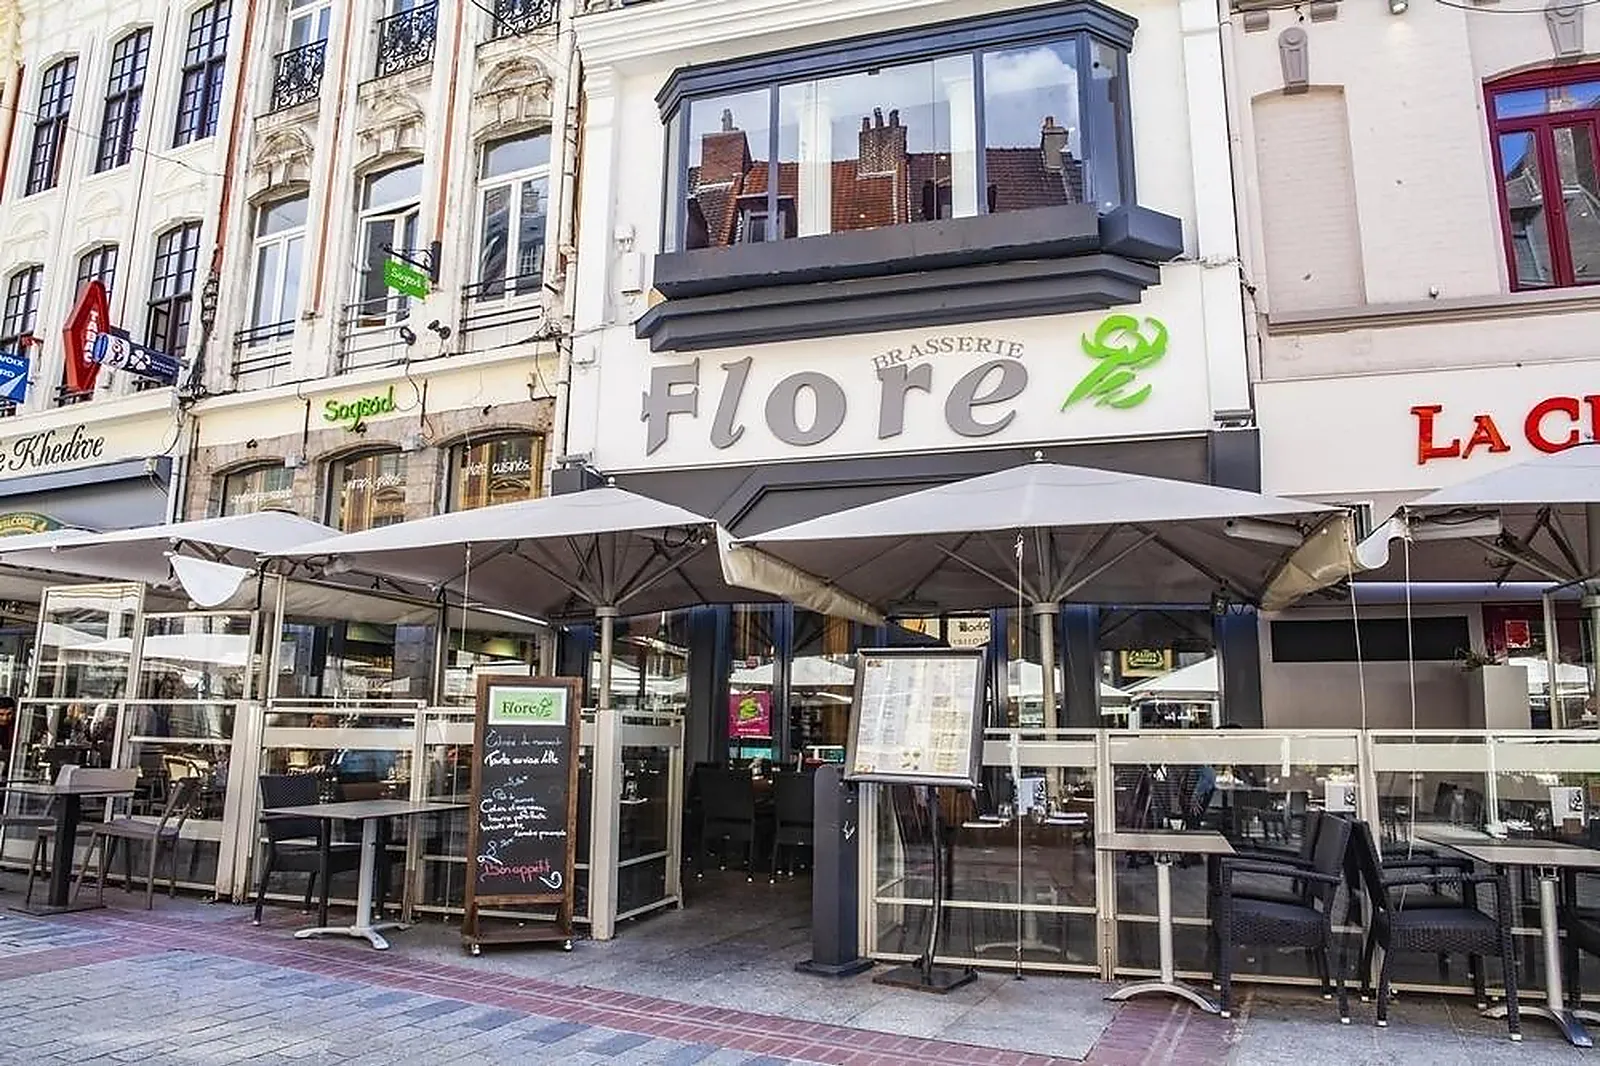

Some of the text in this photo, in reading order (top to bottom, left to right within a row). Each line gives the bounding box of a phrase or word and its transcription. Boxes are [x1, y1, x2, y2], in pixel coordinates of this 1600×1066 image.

[871, 336, 1025, 370] BRASSERIE
[641, 356, 1029, 456] Flore
[9, 424, 105, 471] Khedive
[1410, 404, 1511, 465] LA
[502, 701, 537, 714] Flore
